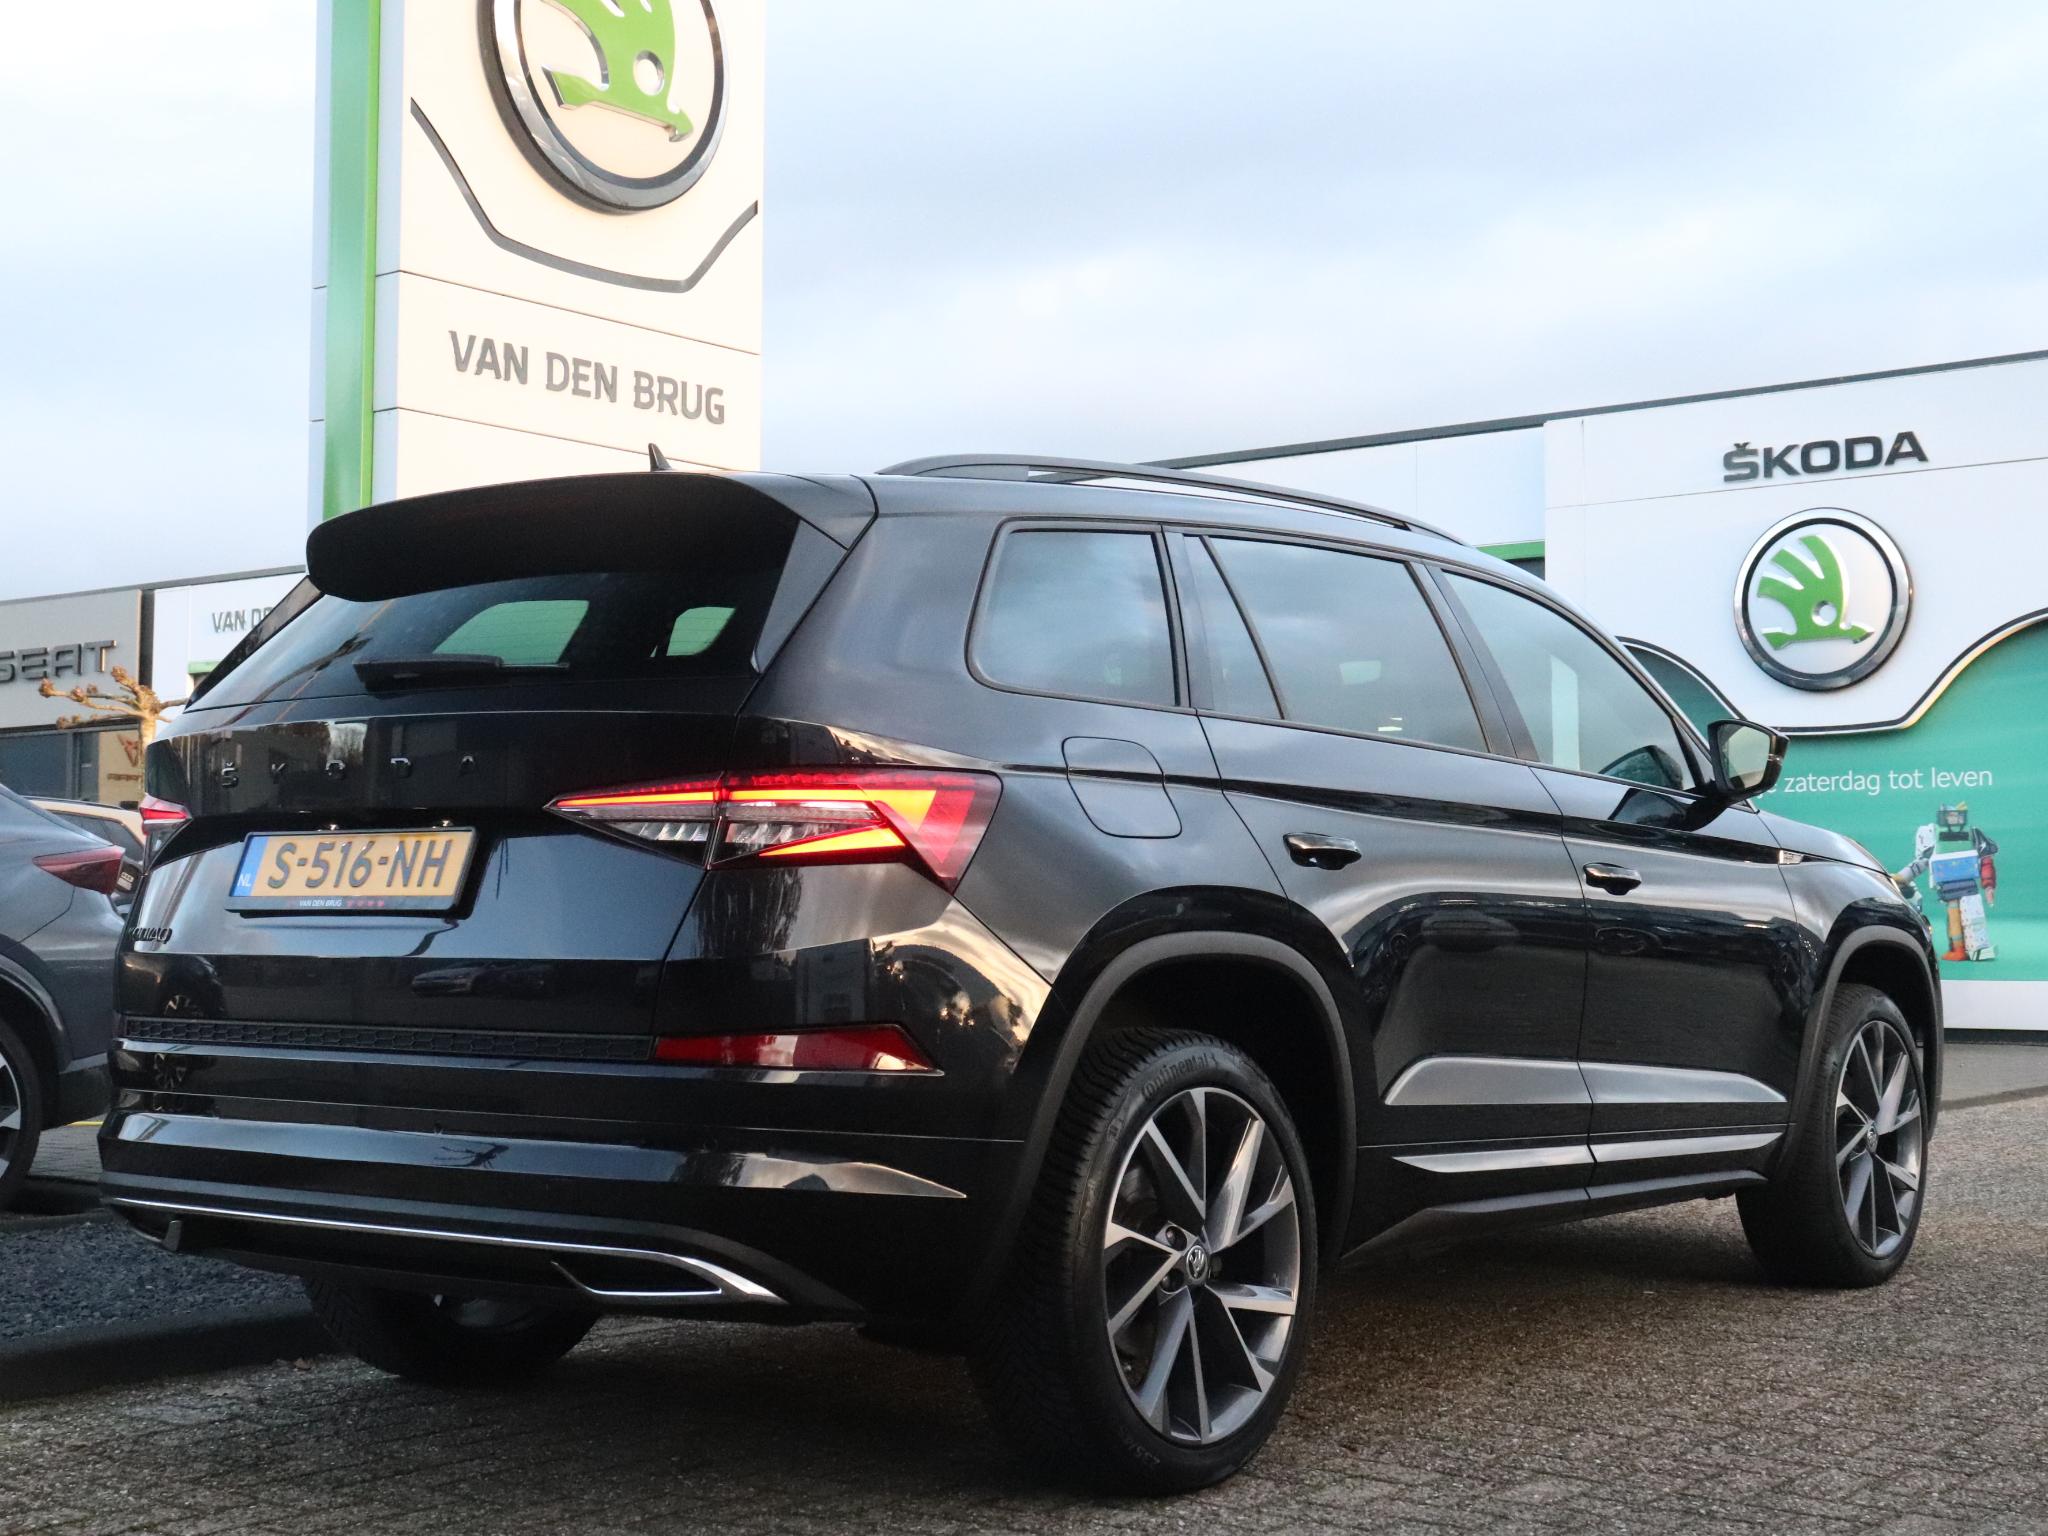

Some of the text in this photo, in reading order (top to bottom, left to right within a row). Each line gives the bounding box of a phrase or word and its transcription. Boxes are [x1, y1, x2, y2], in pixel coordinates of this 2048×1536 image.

[448, 330, 725, 425] VAN DEN BRUG
[1723, 430, 1929, 482] ŠKODA
[212, 610, 246, 633] VAN
[0, 640, 117, 683] SEAT
[1784, 769, 1880, 796] zaterdag
[1888, 767, 1923, 790] tot
[1931, 766, 1993, 788] leven
[237, 873, 252, 888] NL
[267, 837, 454, 890] S-516-NH
